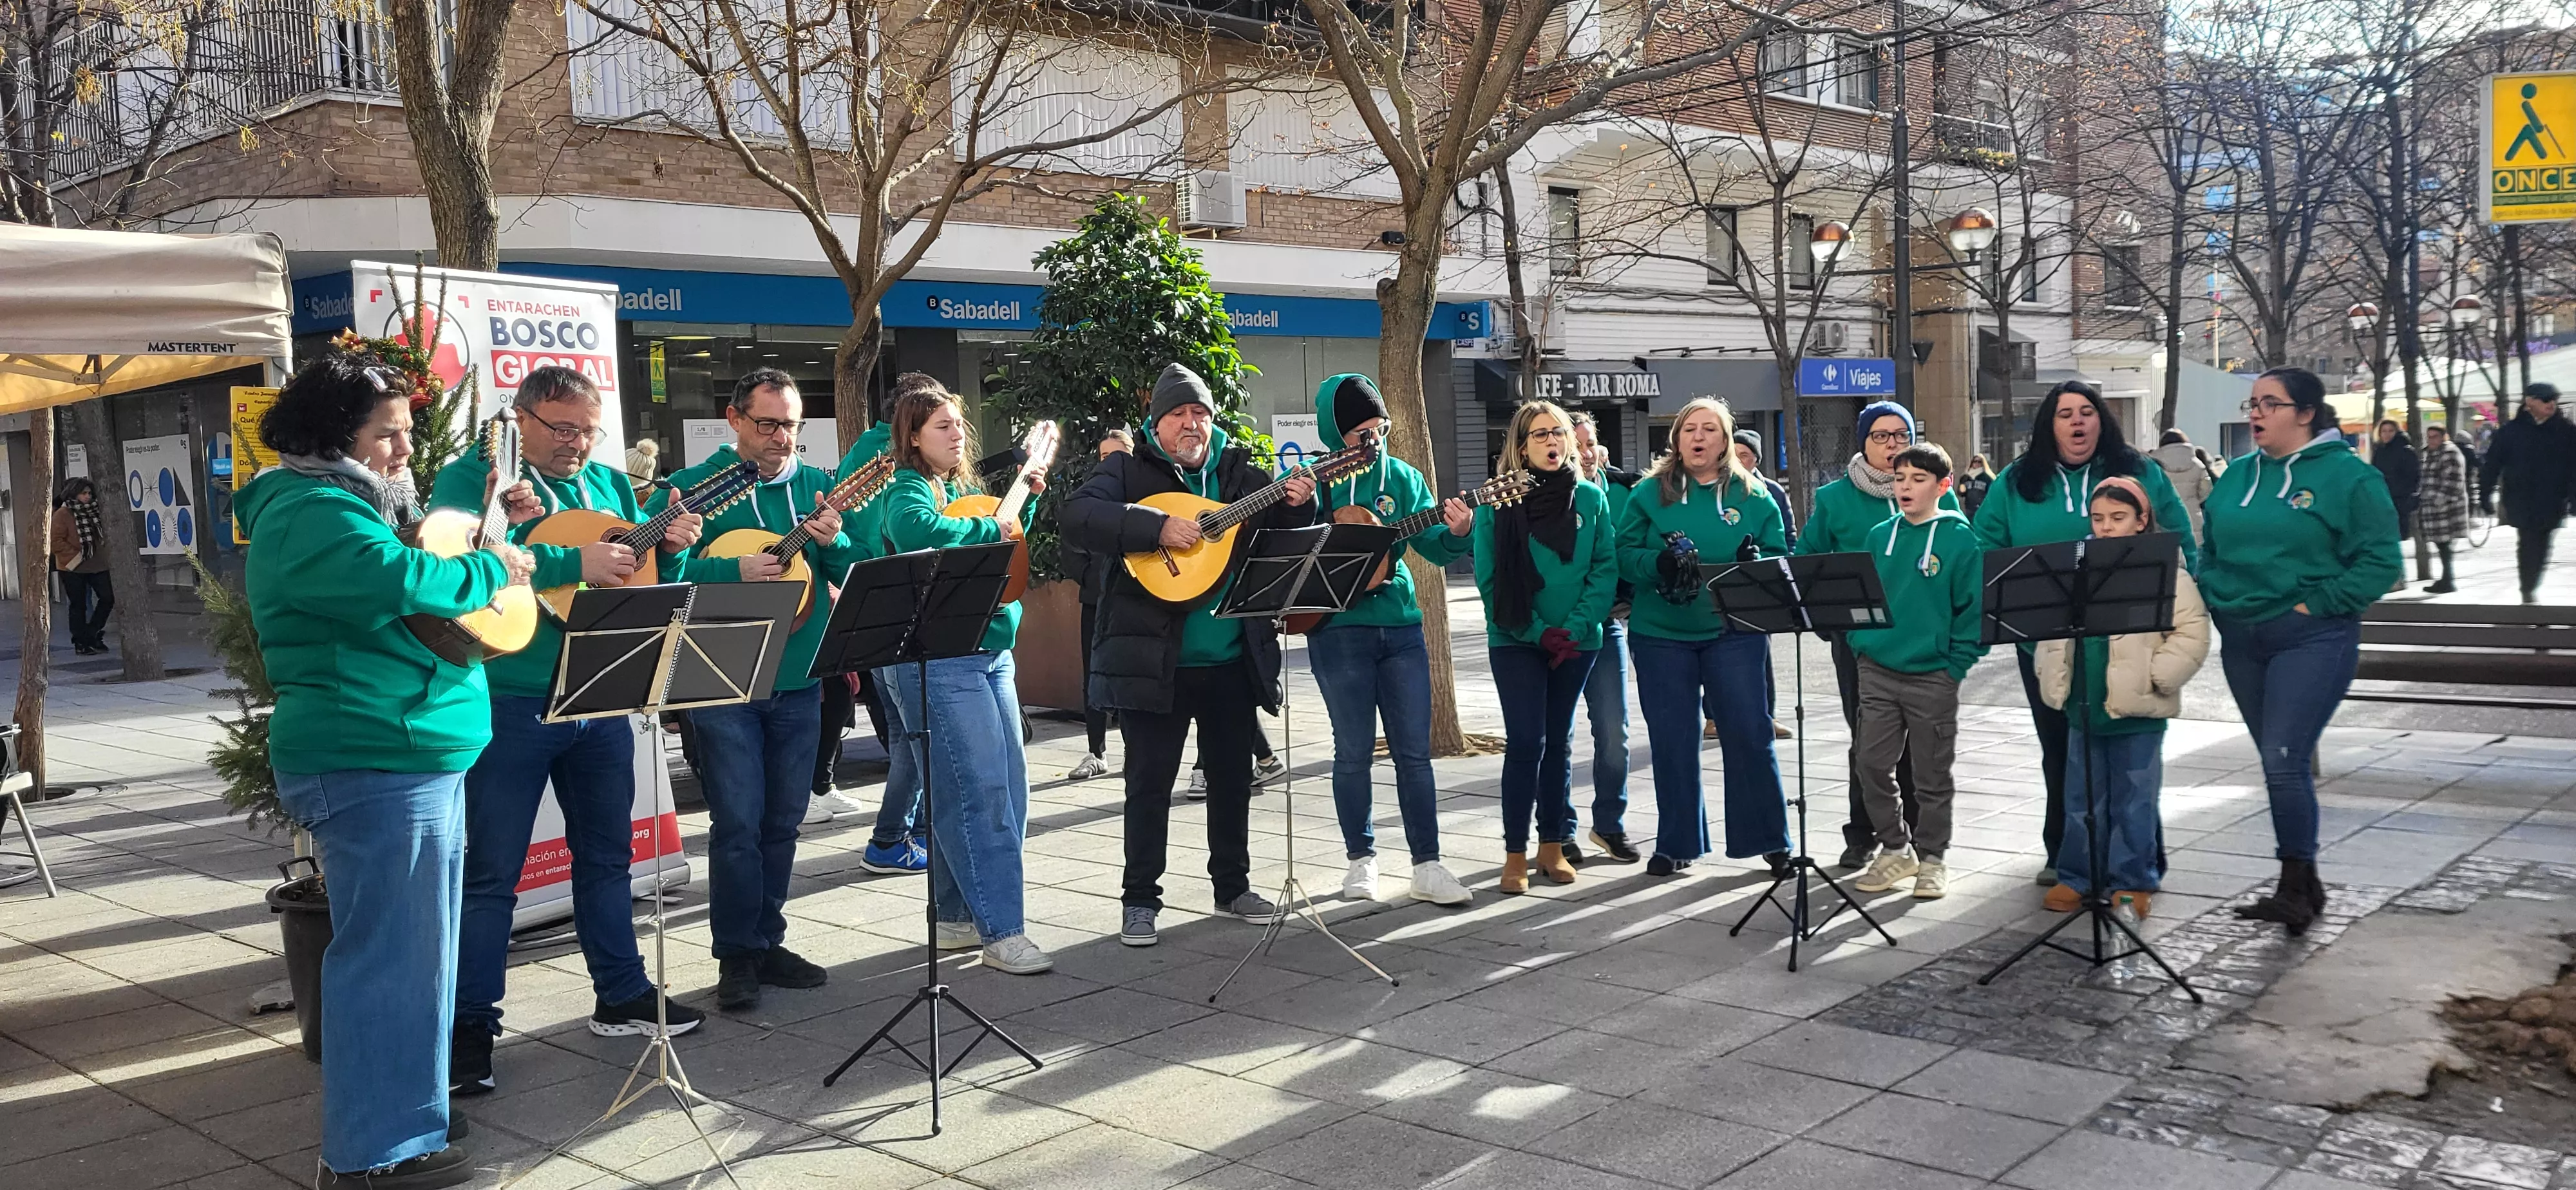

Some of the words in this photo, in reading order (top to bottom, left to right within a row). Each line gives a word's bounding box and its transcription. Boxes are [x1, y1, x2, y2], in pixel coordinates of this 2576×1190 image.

[2494, 169, 2576, 192] ONCE
[312, 292, 354, 319] Sabade
[488, 299, 580, 317] ENTARACHEN
[616, 288, 682, 311] adell
[940, 298, 1020, 321] Sabadell
[1226, 309, 1278, 328] abadell
[489, 316, 600, 350] BOSCO
[147, 341, 236, 353] MASTERTENT
[1578, 373, 1611, 397] BAR
[1615, 373, 1660, 397] ROMA
[1850, 368, 1881, 390] Viajes
